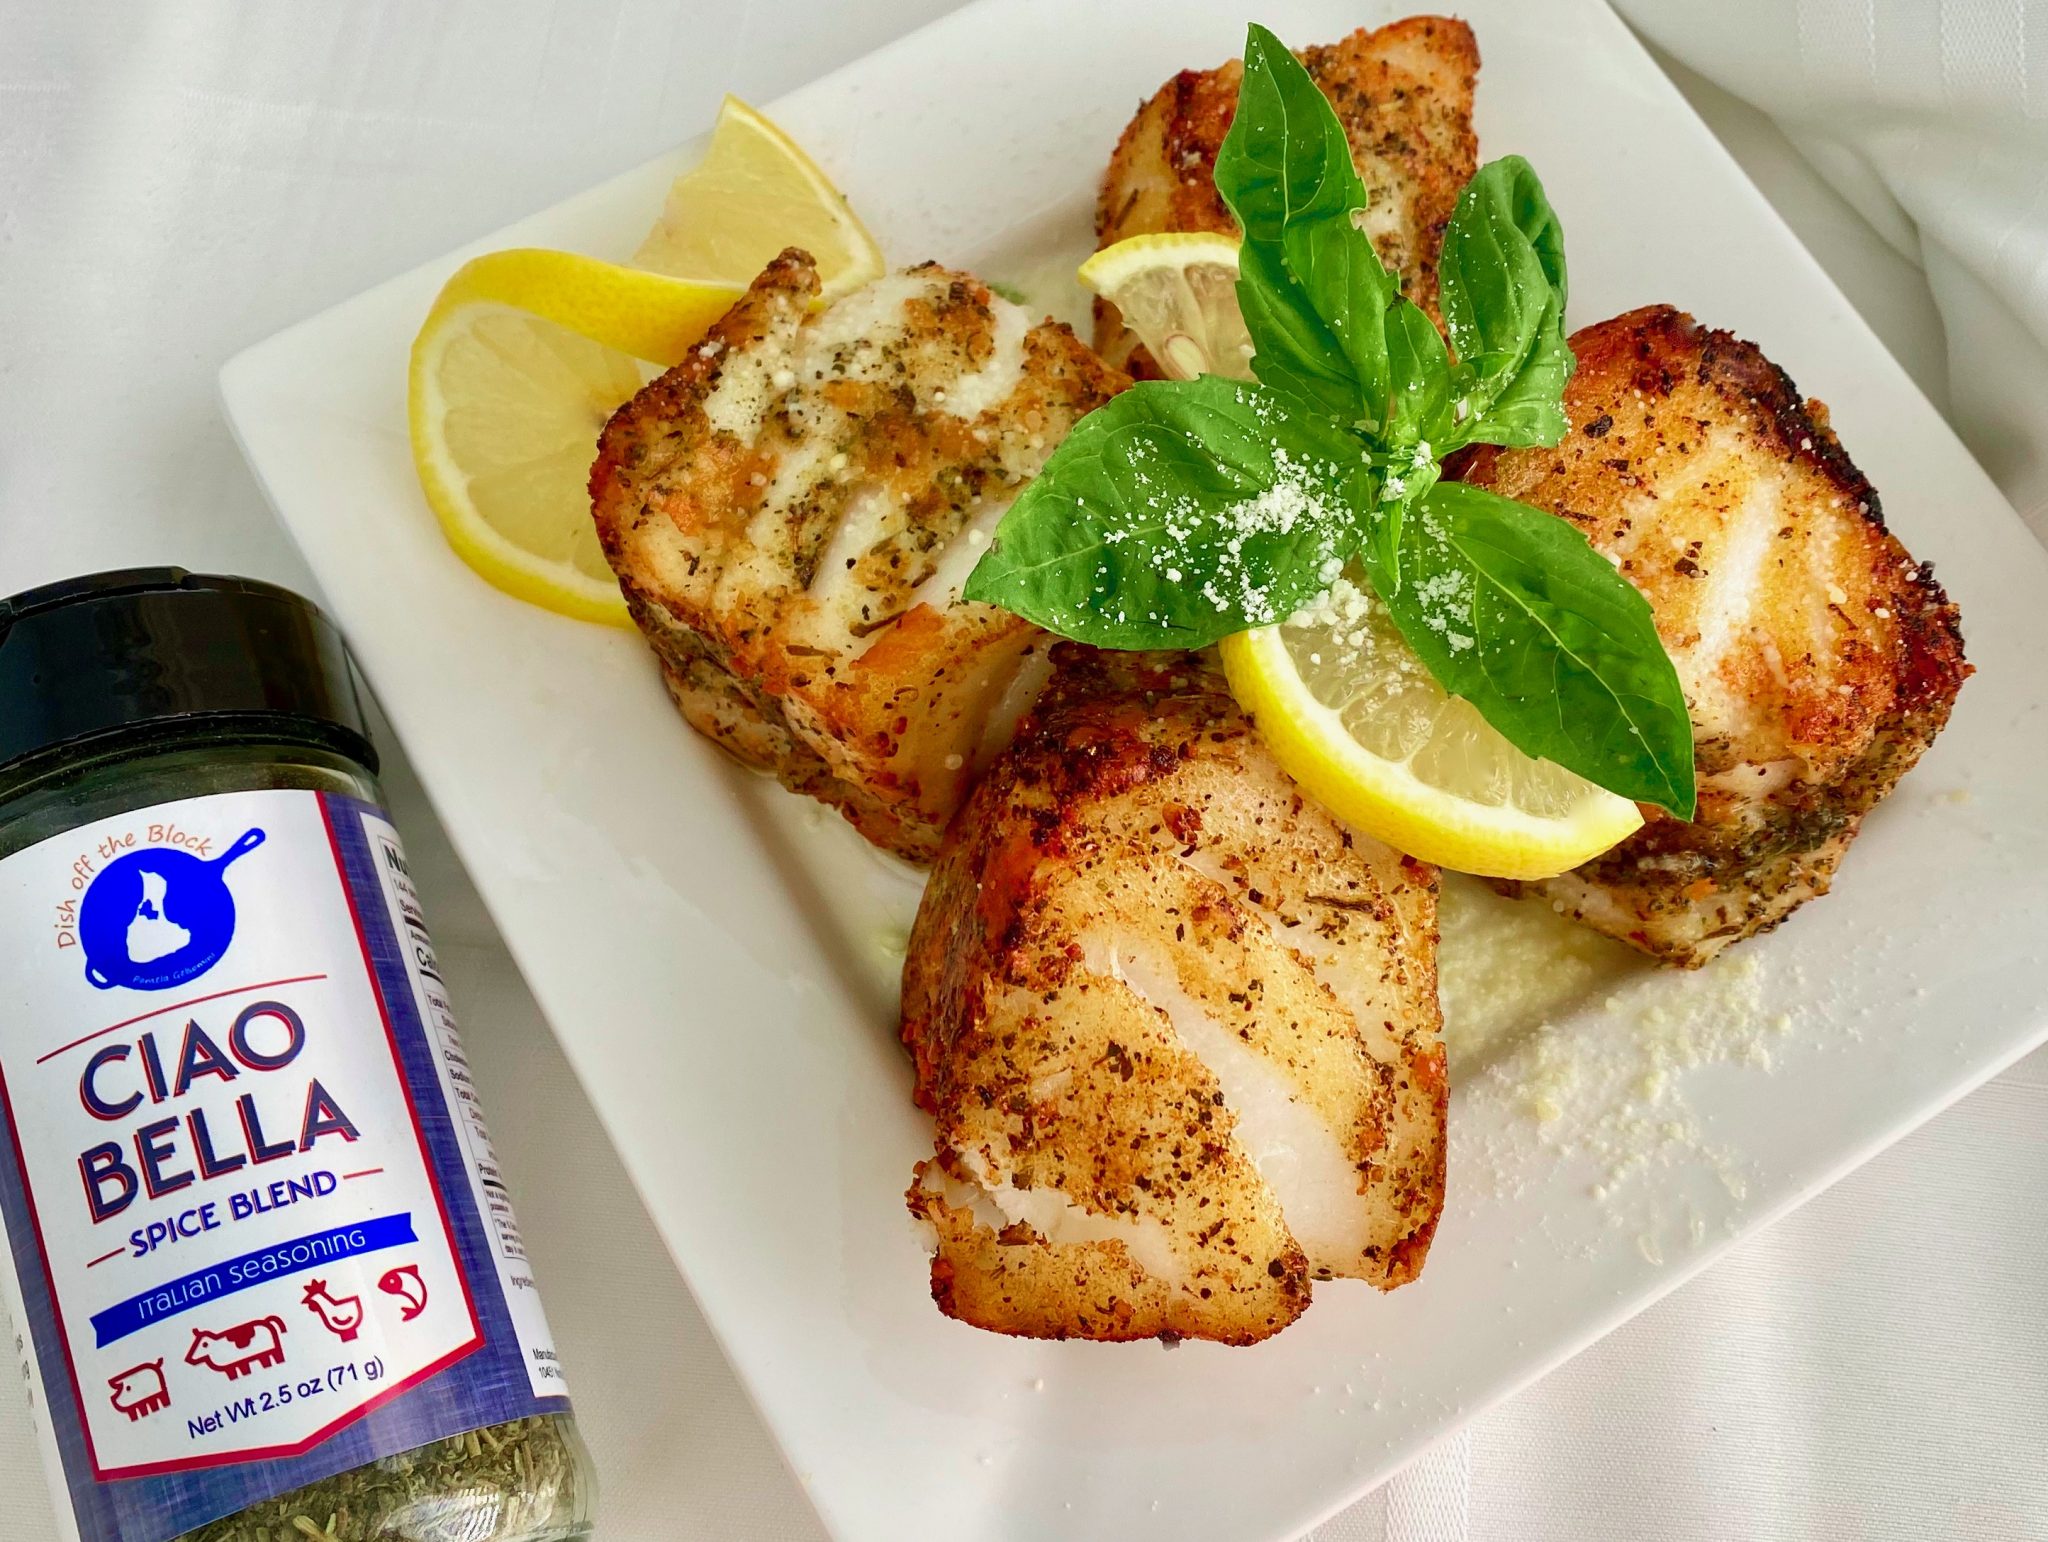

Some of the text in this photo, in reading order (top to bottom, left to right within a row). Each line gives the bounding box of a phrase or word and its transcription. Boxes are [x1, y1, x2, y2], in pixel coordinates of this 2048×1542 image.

[55, 824, 213, 949] Dish off the Block
[80, 1000, 306, 1121] CIAO
[78, 1077, 361, 1225] BELLA
[129, 1170, 337, 1258] SPICE BLEND
[187, 1355, 384, 1439] Net Wt 2.5 oz (71 g)
